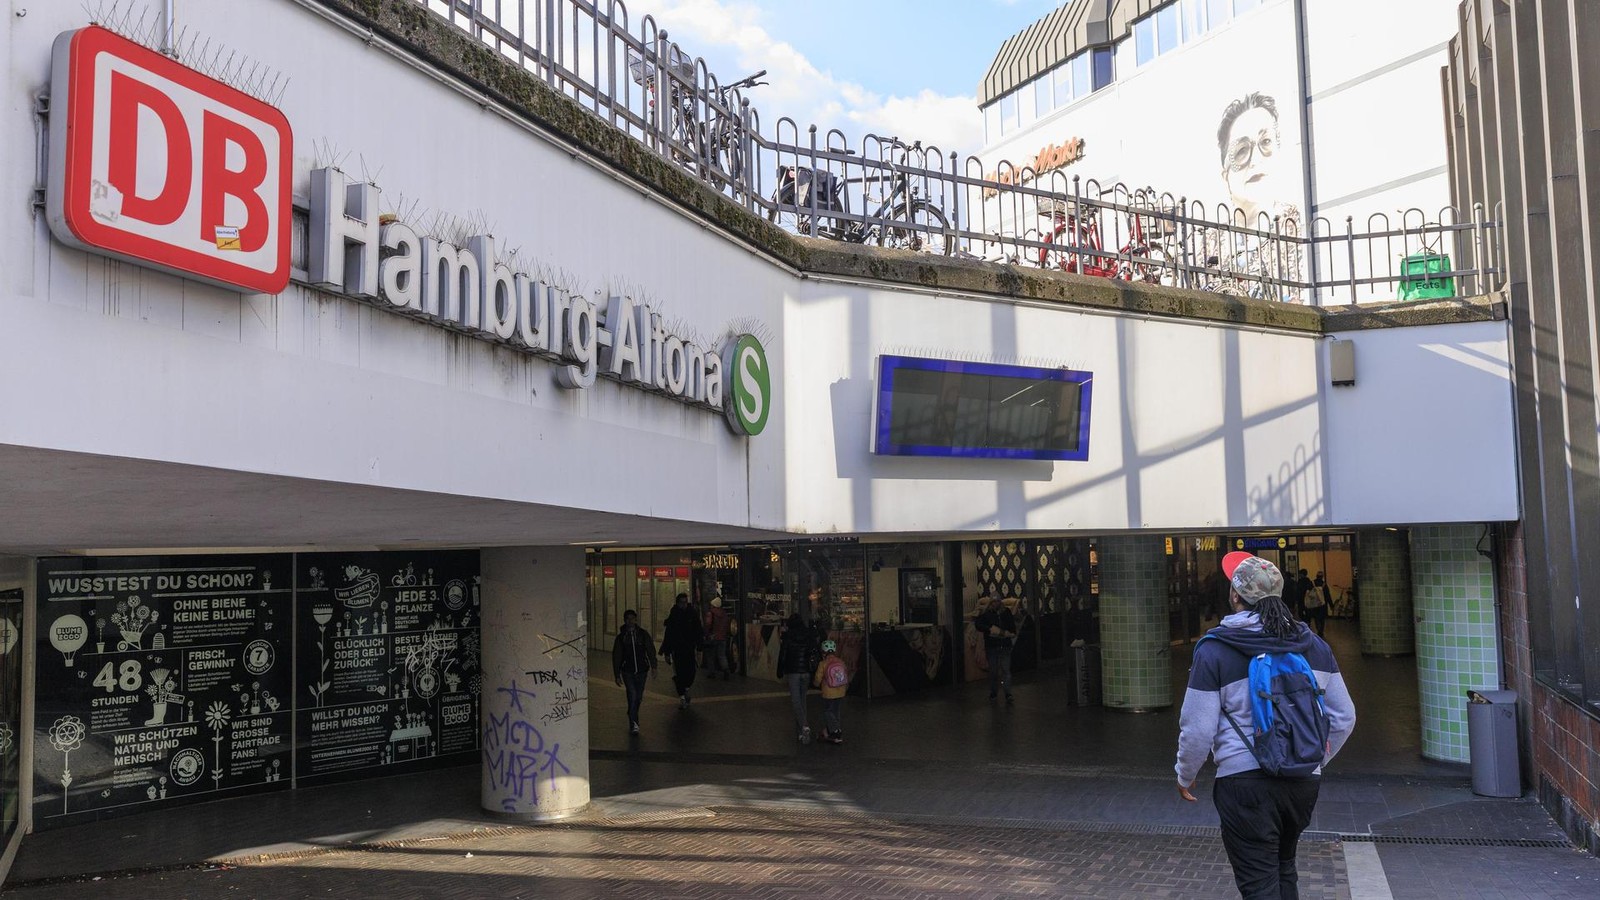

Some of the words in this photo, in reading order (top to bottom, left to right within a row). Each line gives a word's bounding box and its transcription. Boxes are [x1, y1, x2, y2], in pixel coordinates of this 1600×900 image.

[108, 69, 269, 252] DB
[1033, 136, 1080, 173] Markt
[309, 167, 723, 406] Hamburg-Altona
[1415, 280, 1440, 290] Eats
[738, 346, 762, 424] S
[49, 576, 151, 594] WUSSTEST
[156, 575, 182, 590] DU
[186, 573, 254, 589] SCHON?
[350, 584, 370, 596] LIEBEN
[395, 591, 426, 603] JEDE
[430, 590, 440, 602] 3.
[173, 599, 208, 611] OHNE
[211, 597, 246, 609] BIENE
[395, 603, 433, 614] PFLANZE
[173, 611, 209, 623] KEINE
[213, 609, 255, 621] BLUME!
[56, 626, 82, 635] BLUME
[334, 637, 385, 650] GLÜCKLICH
[395, 635, 420, 645] BESTE
[188, 649, 226, 661] FRISCH
[255, 650, 263, 661] 7
[334, 648, 359, 660] ODER
[362, 647, 386, 657] GELD
[395, 644, 422, 655] BESTE
[188, 658, 236, 671] GEWINNT
[92, 660, 142, 693] 48
[91, 695, 139, 707] STUNDEN
[312, 709, 347, 721] WILLST
[348, 707, 361, 717] DU
[363, 704, 389, 715] NOCH
[442, 704, 470, 716] BLUME
[231, 720, 250, 730] WIR
[252, 717, 273, 727] SIND
[312, 720, 340, 732] MEHR
[342, 715, 380, 728] WISSEN?
[114, 732, 137, 745] WIR
[138, 726, 198, 742] SCHÜTZEN
[231, 727, 269, 740] GROSSE
[114, 743, 154, 756] NATUR
[156, 739, 179, 750] UND
[231, 736, 281, 750] FAIRTRADE
[114, 752, 162, 767] MENSCH
[172, 750, 203, 770] NACHHALTIGER
[231, 748, 258, 760] FANS!
